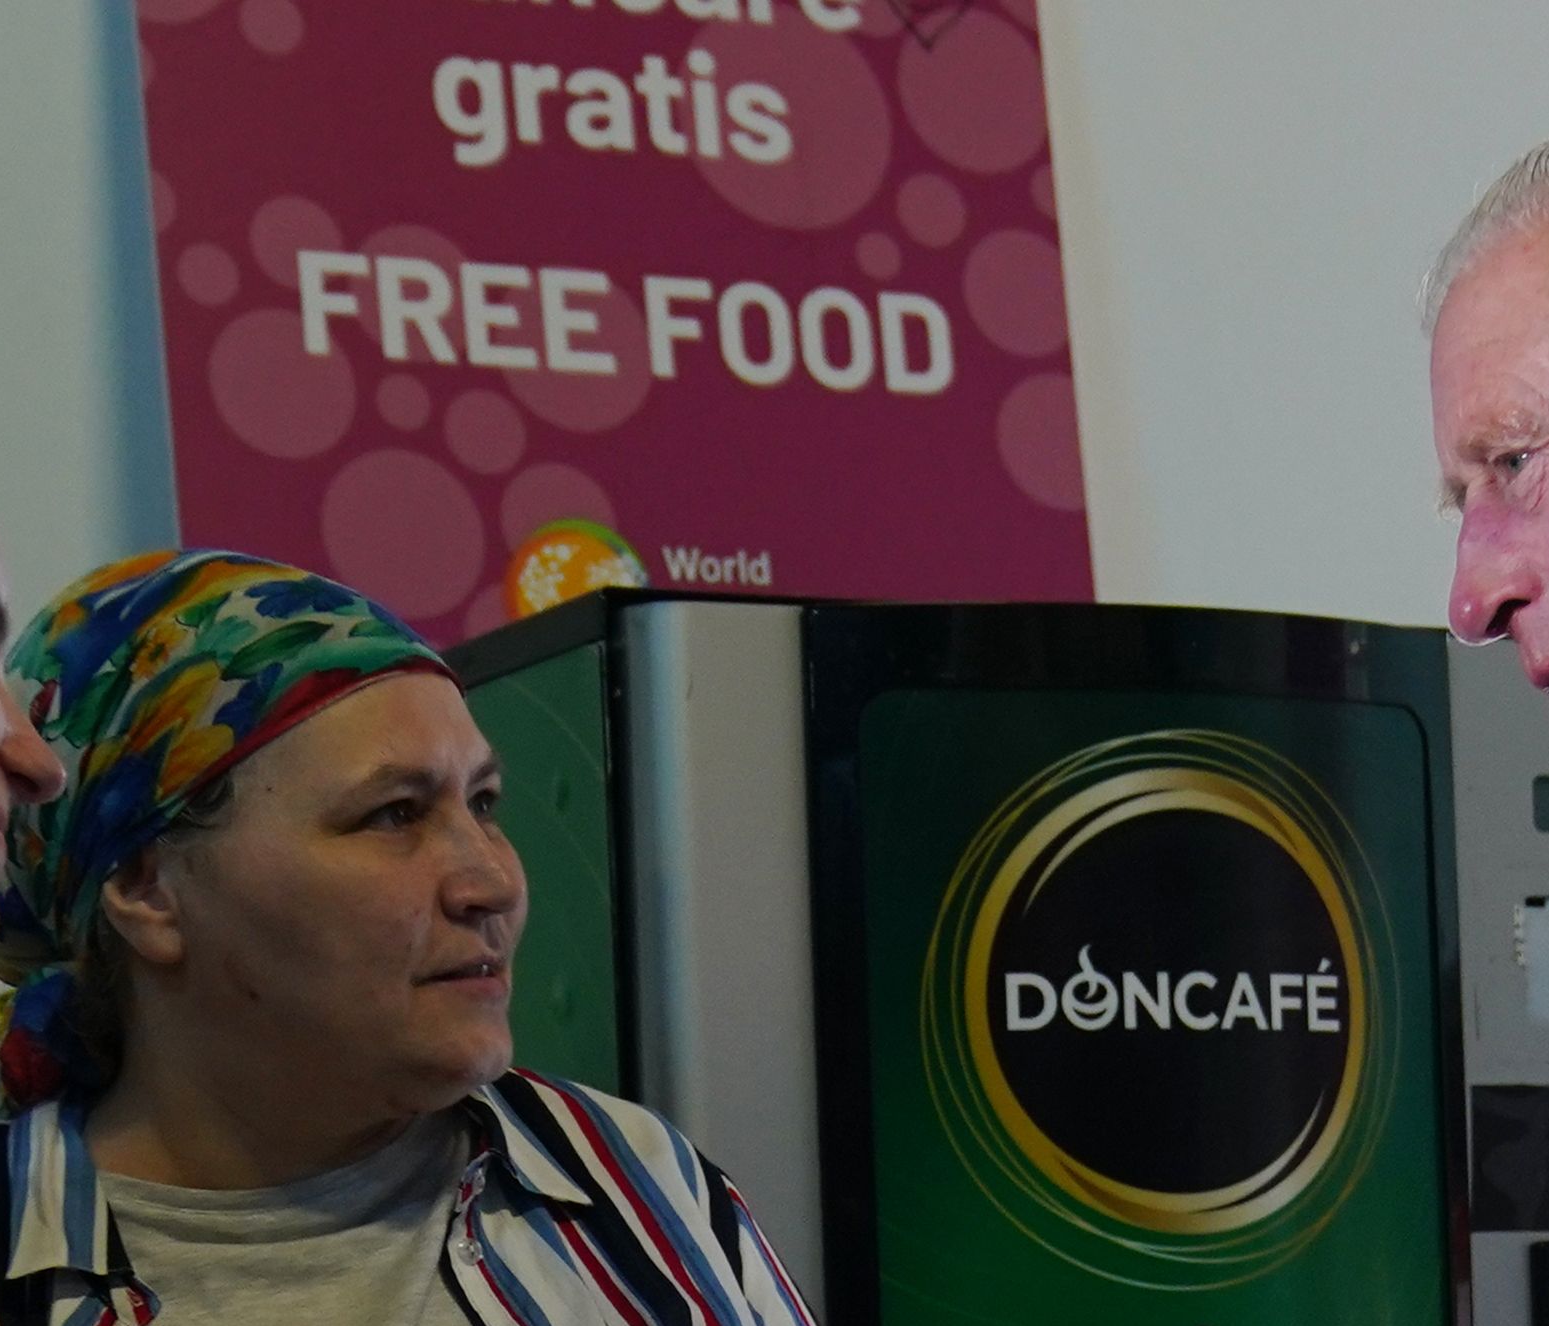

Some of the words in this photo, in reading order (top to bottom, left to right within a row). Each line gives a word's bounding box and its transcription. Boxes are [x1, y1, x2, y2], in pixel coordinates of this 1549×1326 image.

[431, 49, 794, 168] gratis
[295, 249, 620, 377] FREE
[644, 274, 955, 396] FOOD
[662, 544, 773, 586] World
[1003, 945, 1341, 1033] DONCAFÉ
